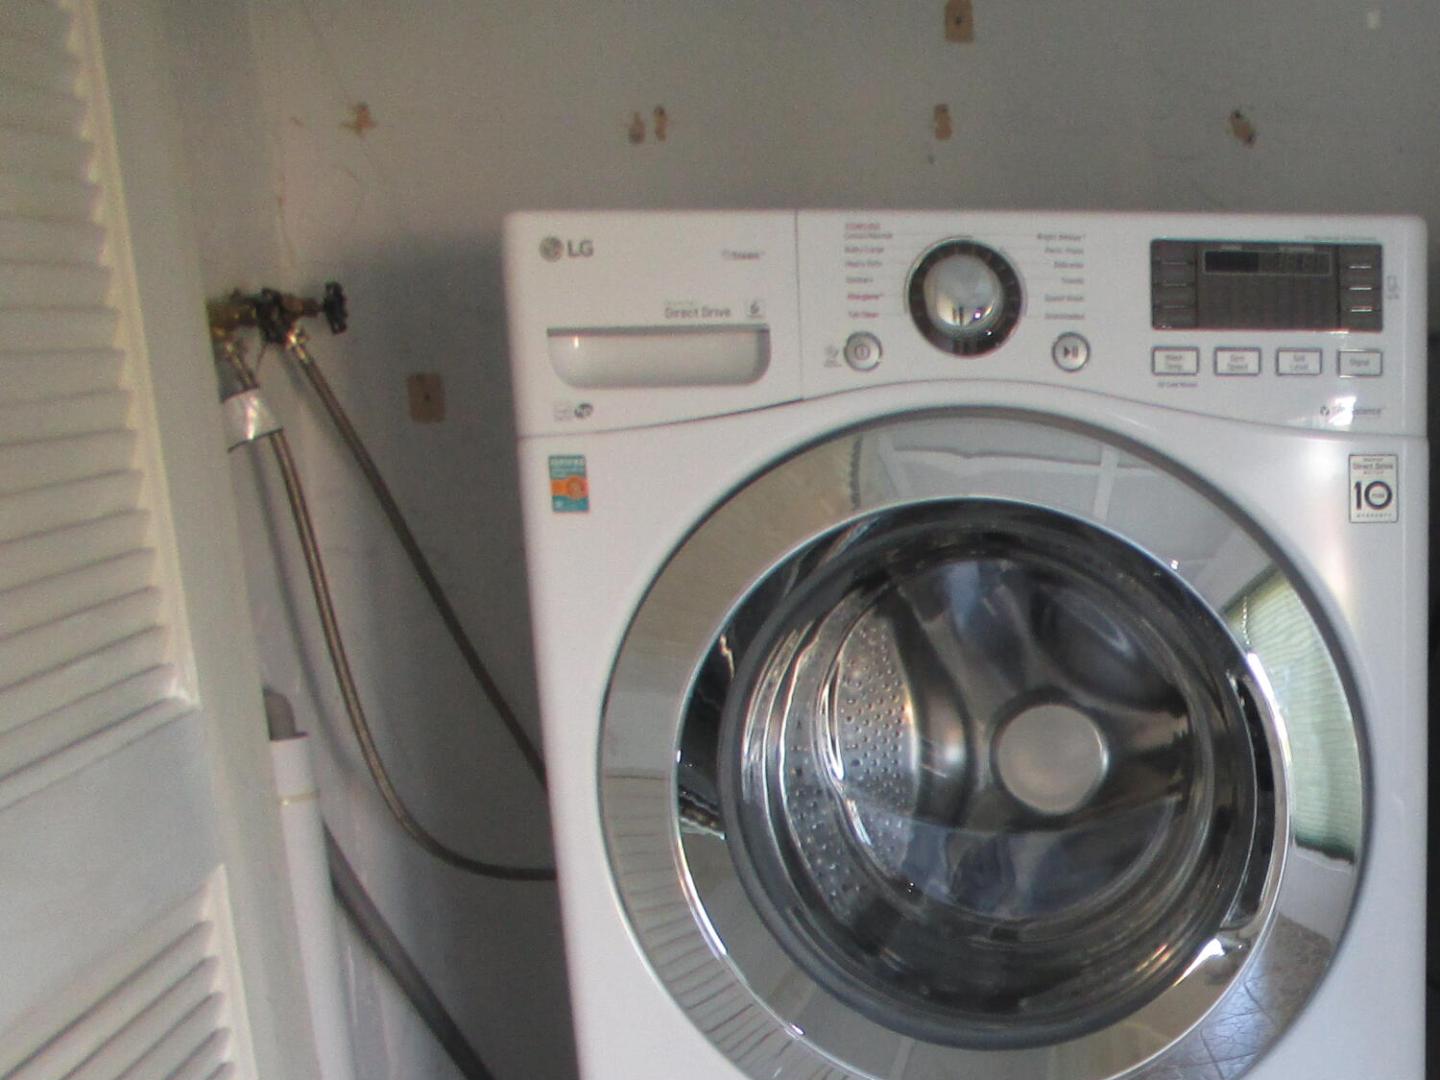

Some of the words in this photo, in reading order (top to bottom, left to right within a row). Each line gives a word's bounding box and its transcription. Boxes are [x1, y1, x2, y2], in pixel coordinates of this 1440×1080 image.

[567, 239, 594, 258] LG
[664, 306, 699, 319] Direct
[701, 305, 732, 318] Drive
[1354, 480, 1393, 511] 10
